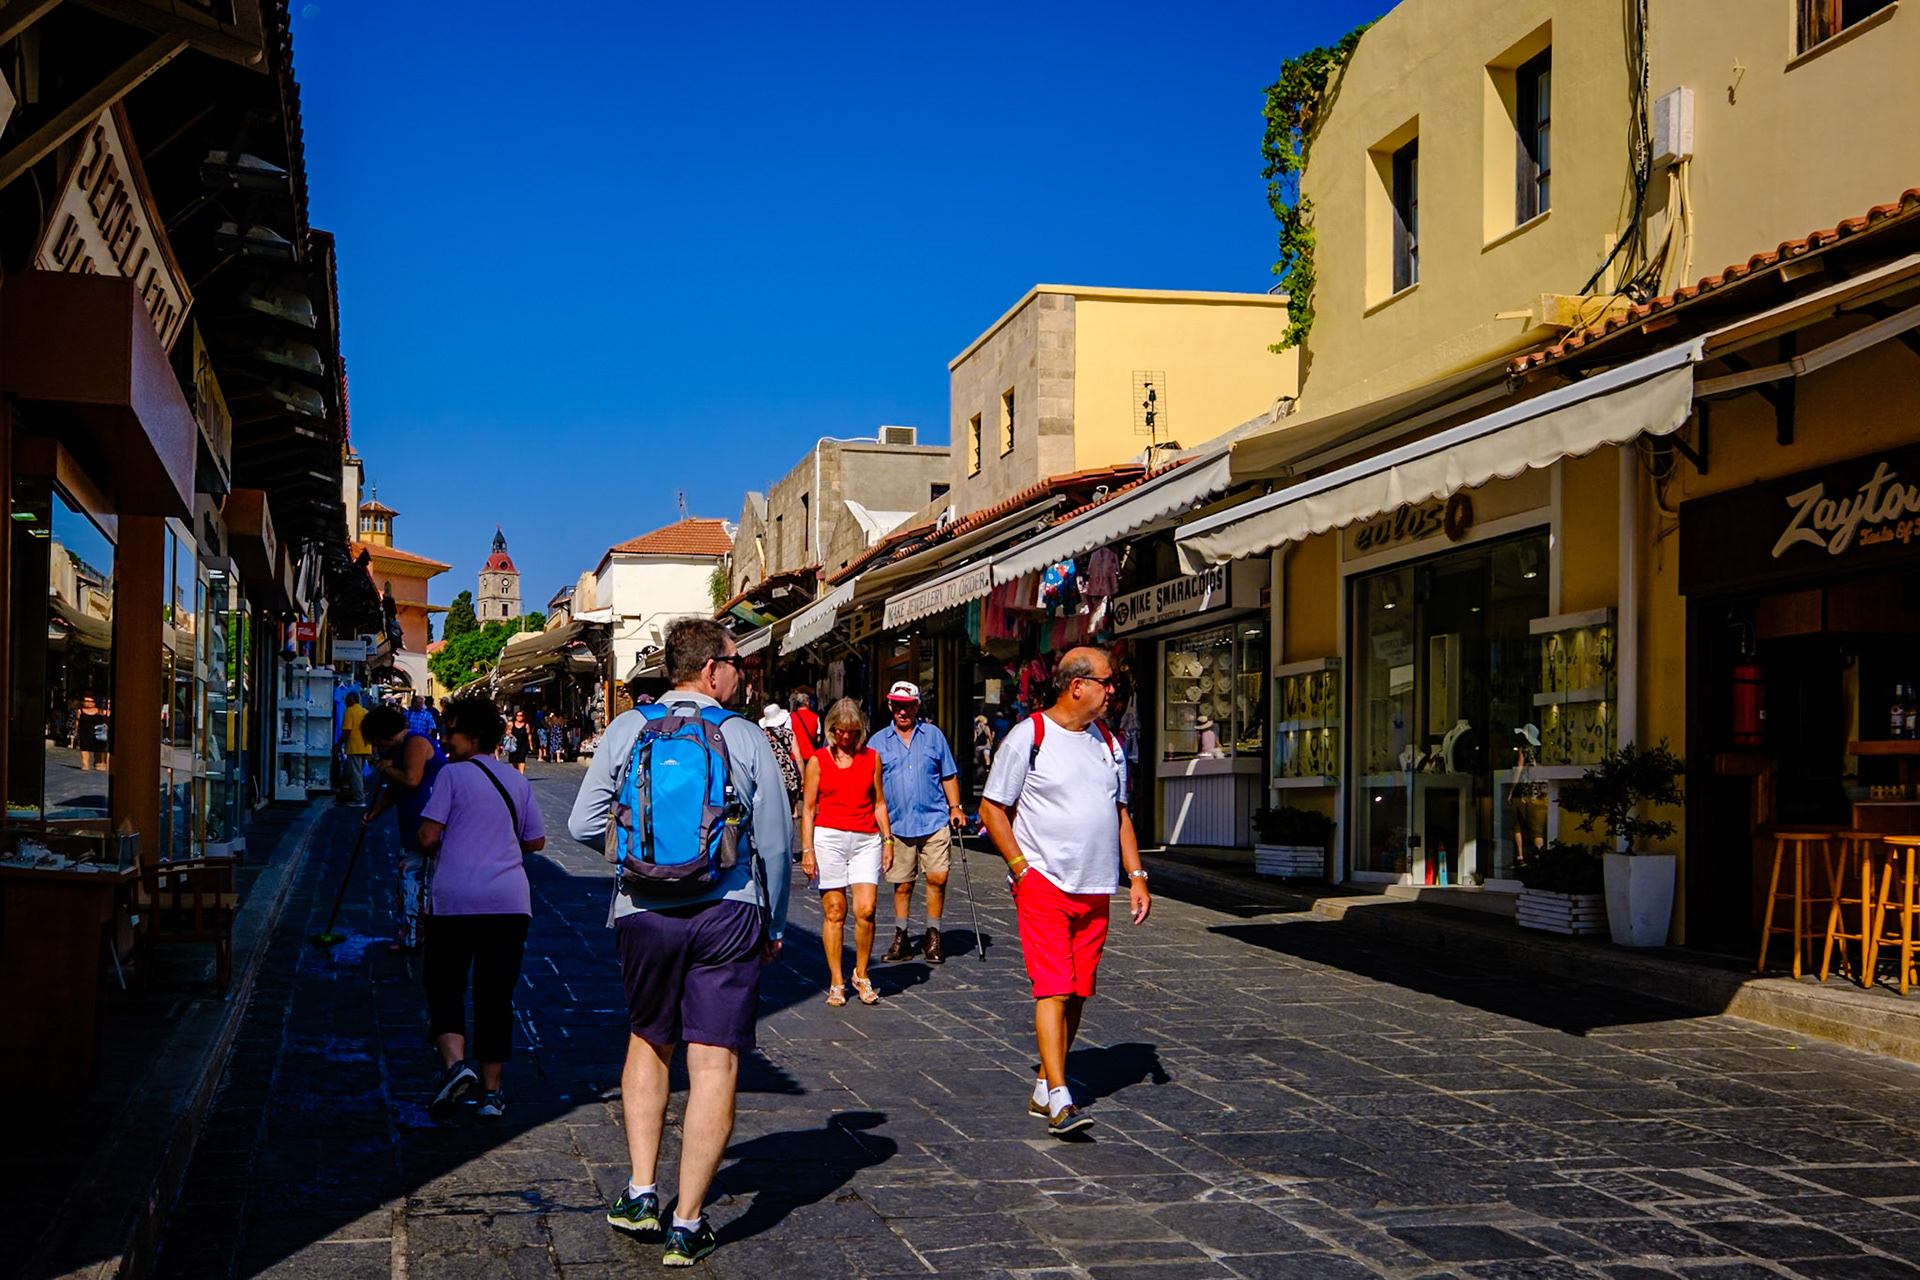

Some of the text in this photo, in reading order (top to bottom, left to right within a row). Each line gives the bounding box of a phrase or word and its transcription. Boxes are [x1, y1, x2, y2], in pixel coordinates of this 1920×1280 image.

[887, 602, 906, 621] MAKE
[907, 588, 944, 616] JEWELLERY
[946, 583, 956, 602] TO
[1130, 591, 1151, 620] MIKE
